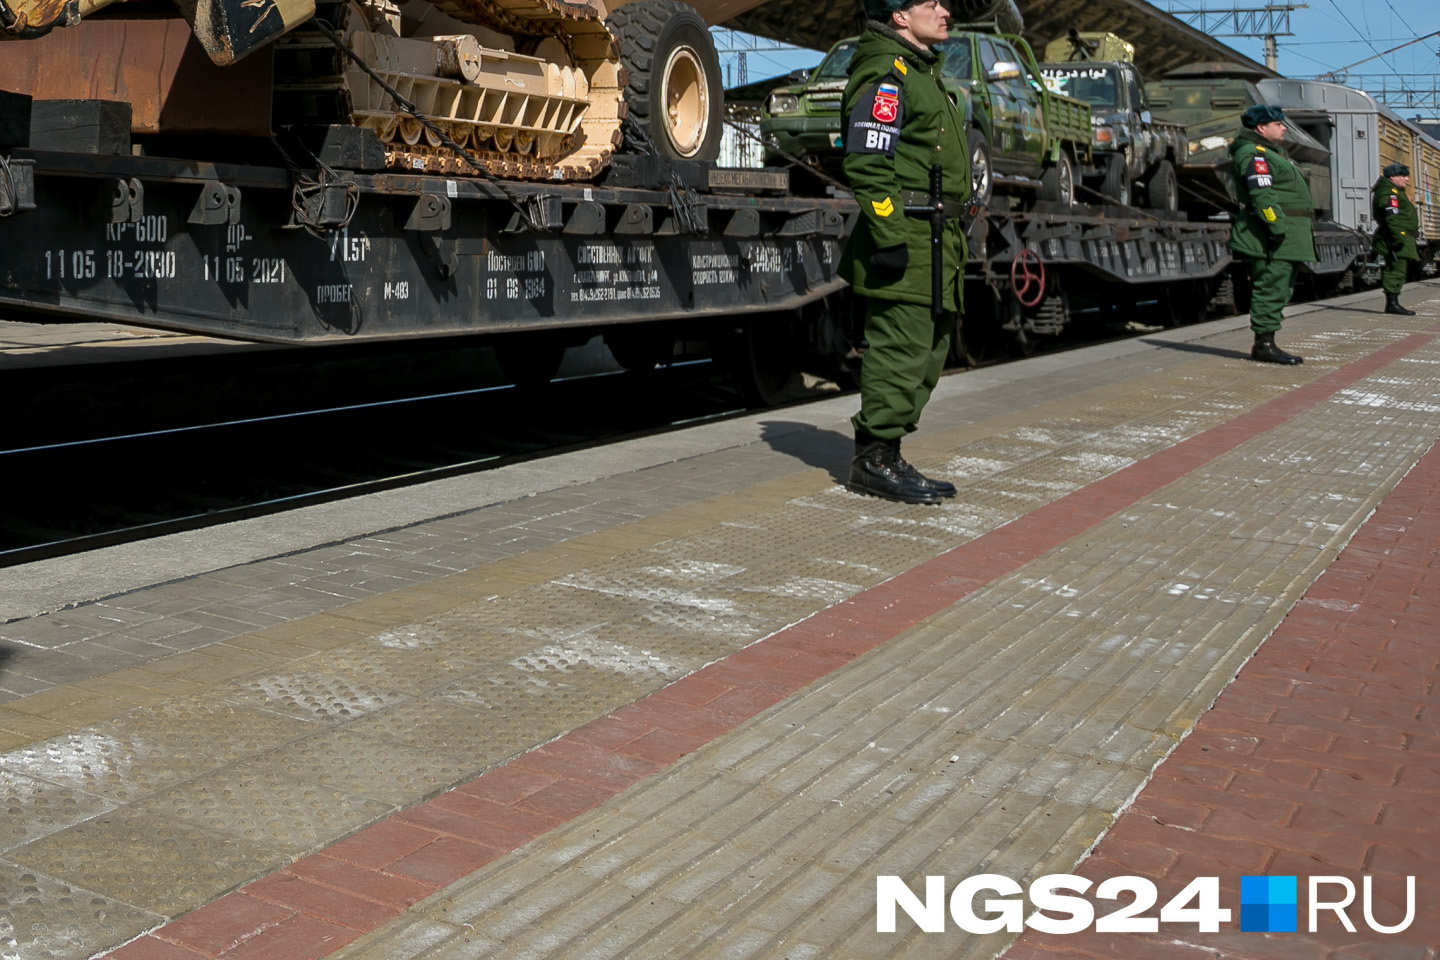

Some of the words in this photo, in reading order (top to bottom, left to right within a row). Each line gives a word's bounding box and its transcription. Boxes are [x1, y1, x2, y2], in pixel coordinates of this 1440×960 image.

[865, 129, 891, 151] ВП
[252, 257, 286, 283] 2021
[487, 250, 525, 272] Построен
[317, 284, 353, 304] ПРОБЕГ
